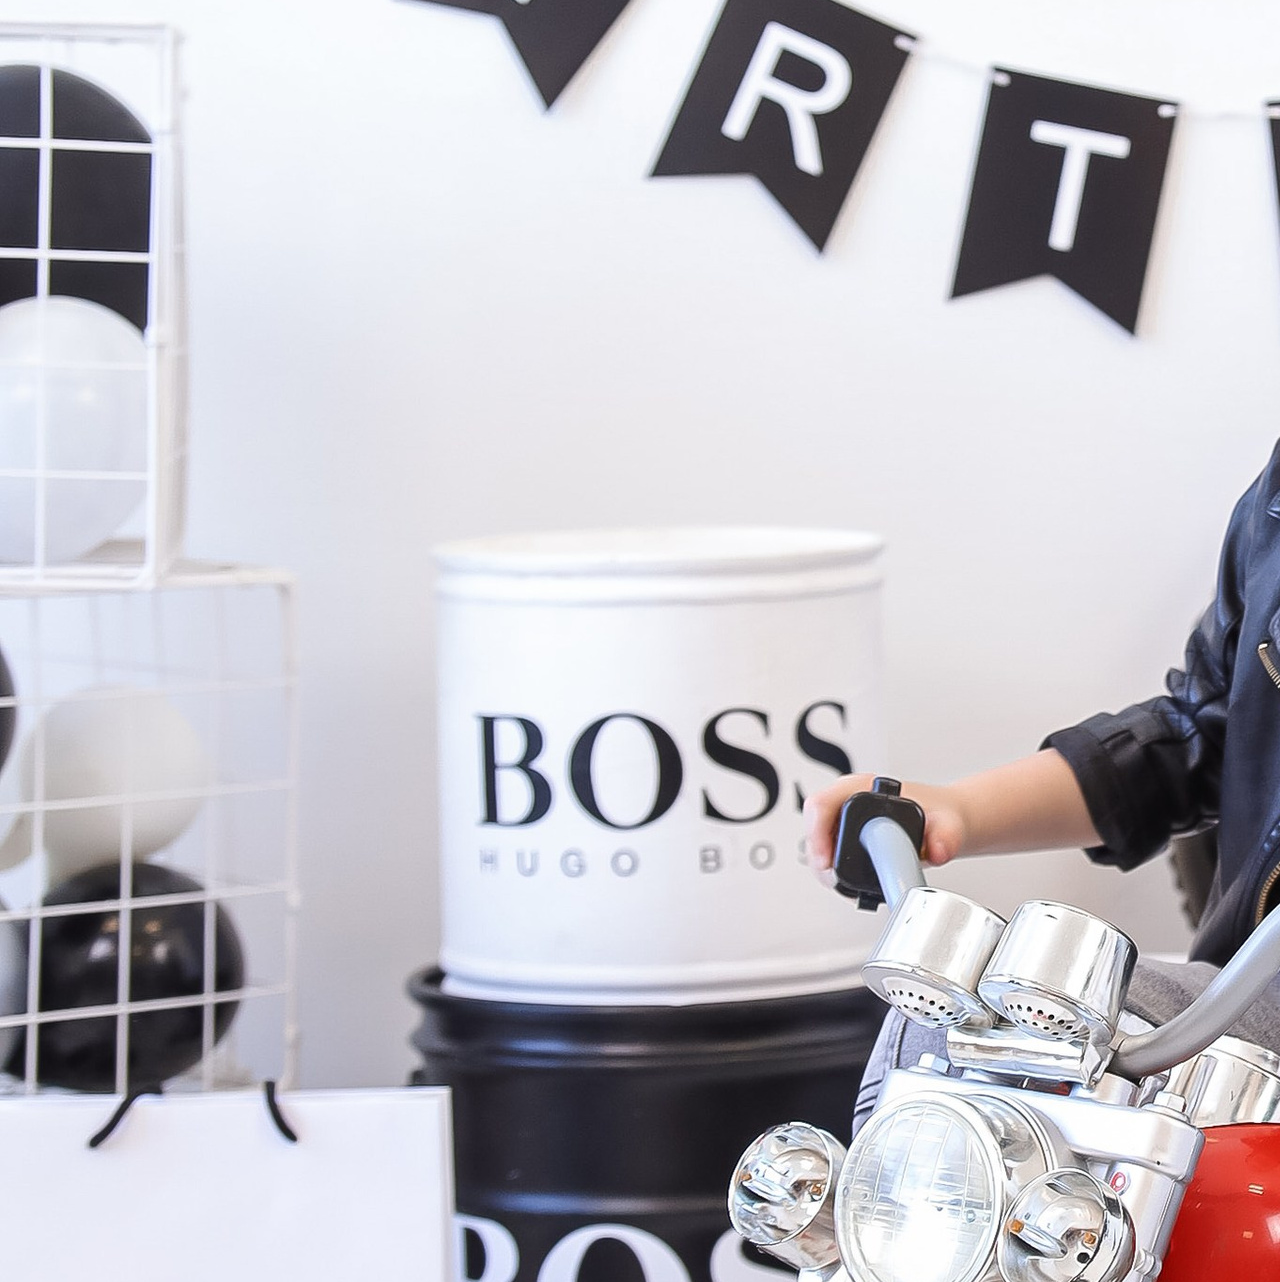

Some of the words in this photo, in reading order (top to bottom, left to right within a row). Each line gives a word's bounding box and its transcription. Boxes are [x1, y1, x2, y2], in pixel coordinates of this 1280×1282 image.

[475, 700, 852, 830] BOSS
[479, 847, 640, 877] HUGO
[699, 840, 808, 874] BO
